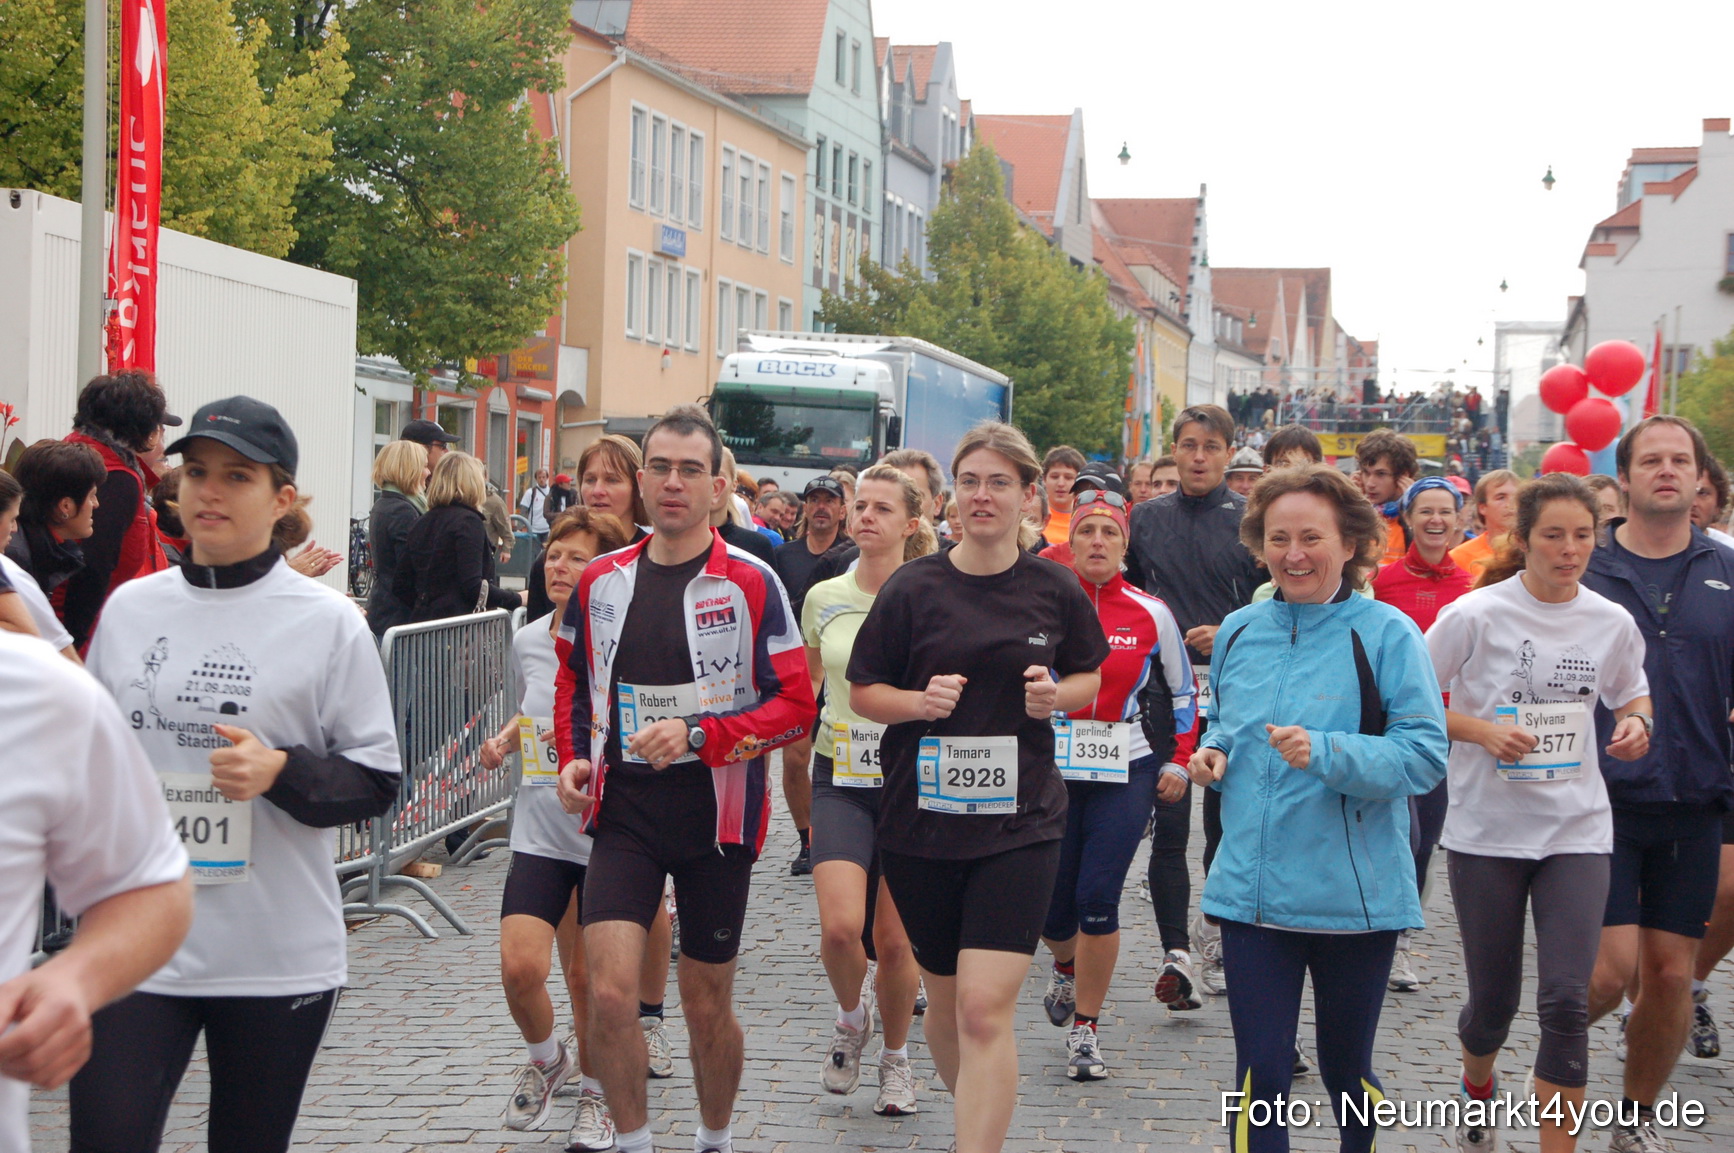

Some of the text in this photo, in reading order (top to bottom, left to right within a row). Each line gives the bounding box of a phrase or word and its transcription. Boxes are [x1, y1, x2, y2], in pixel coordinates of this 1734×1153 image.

[757, 359, 837, 378] BOCK
[697, 608, 733, 629] ULT
[698, 626, 737, 638] www.ult.lu
[1553, 672, 1596, 683] 21.09.2008
[185, 680, 252, 697] 21.09.2008
[1511, 690, 1527, 704] 9.
[639, 692, 678, 708] Robert
[131, 710, 219, 734] 9. Neumar
[1525, 712, 1566, 729] Sylvana
[851, 728, 880, 741] Maria
[1075, 725, 1112, 738] gerlinde
[946, 744, 991, 759] Tamara
[1076, 742, 1120, 760] 3394
[1530, 732, 1576, 755] 2577
[546, 745, 558, 764] 6
[860, 749, 881, 766] 45
[947, 767, 1006, 788] 2928
[977, 801, 1015, 810] PFLEIDERER
[174, 815, 229, 845] 401
